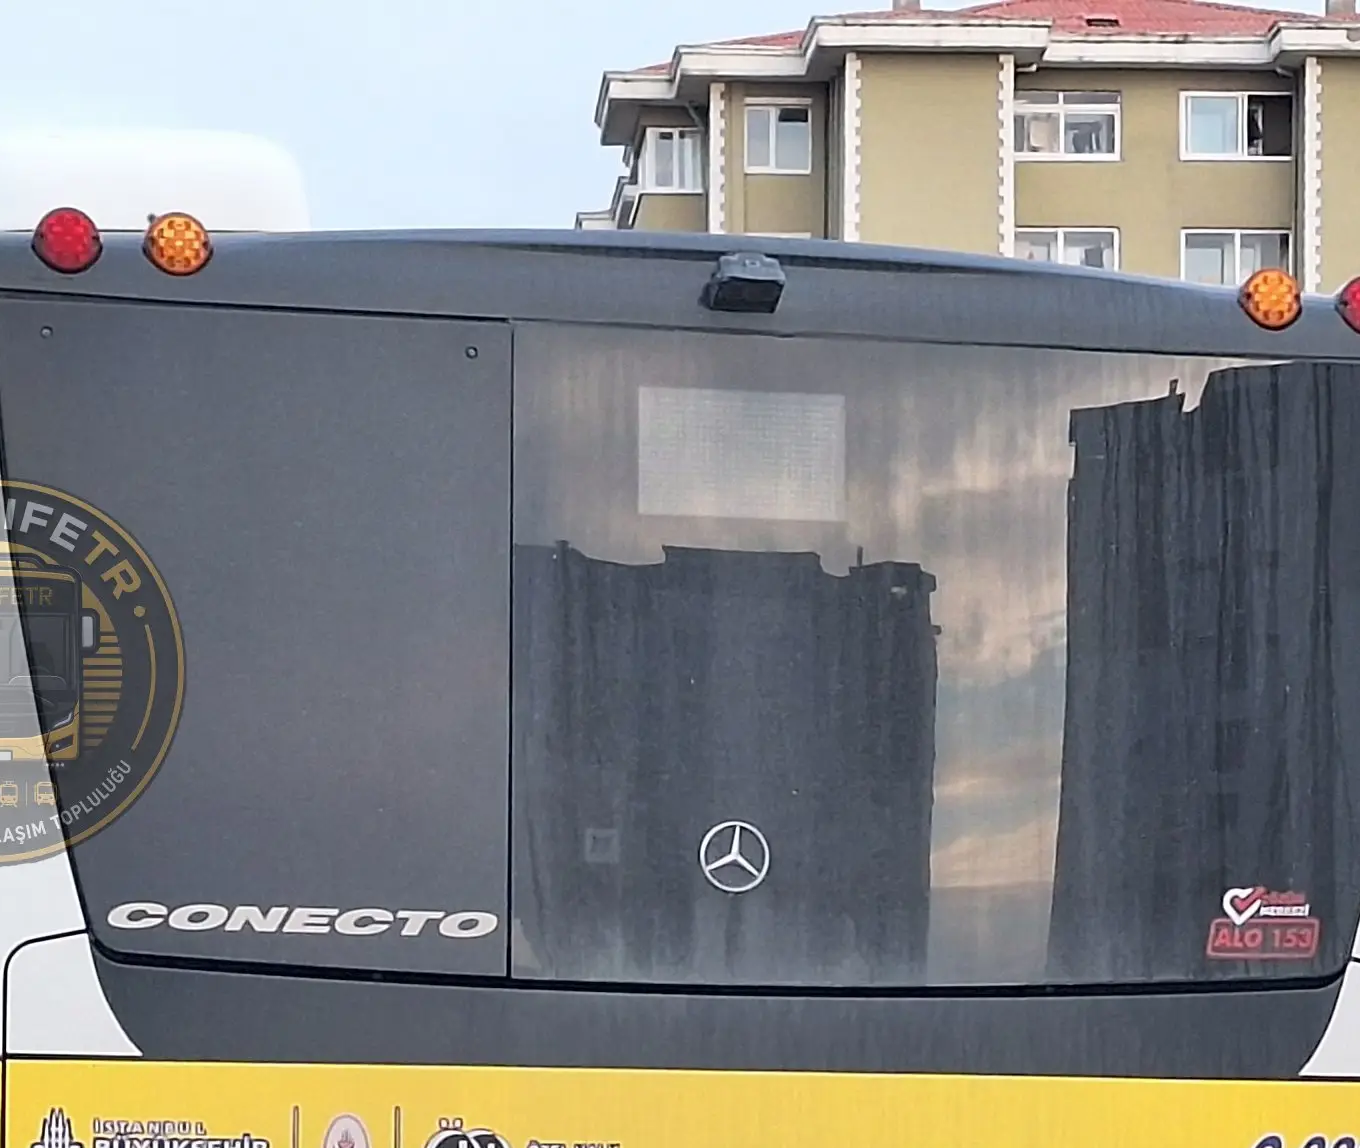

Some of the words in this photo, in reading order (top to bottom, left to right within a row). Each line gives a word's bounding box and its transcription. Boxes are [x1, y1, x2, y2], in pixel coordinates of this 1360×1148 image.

[106, 901, 499, 939] CONECTO
[1213, 927, 1263, 948] ALO
[1272, 927, 1313, 948] 153
